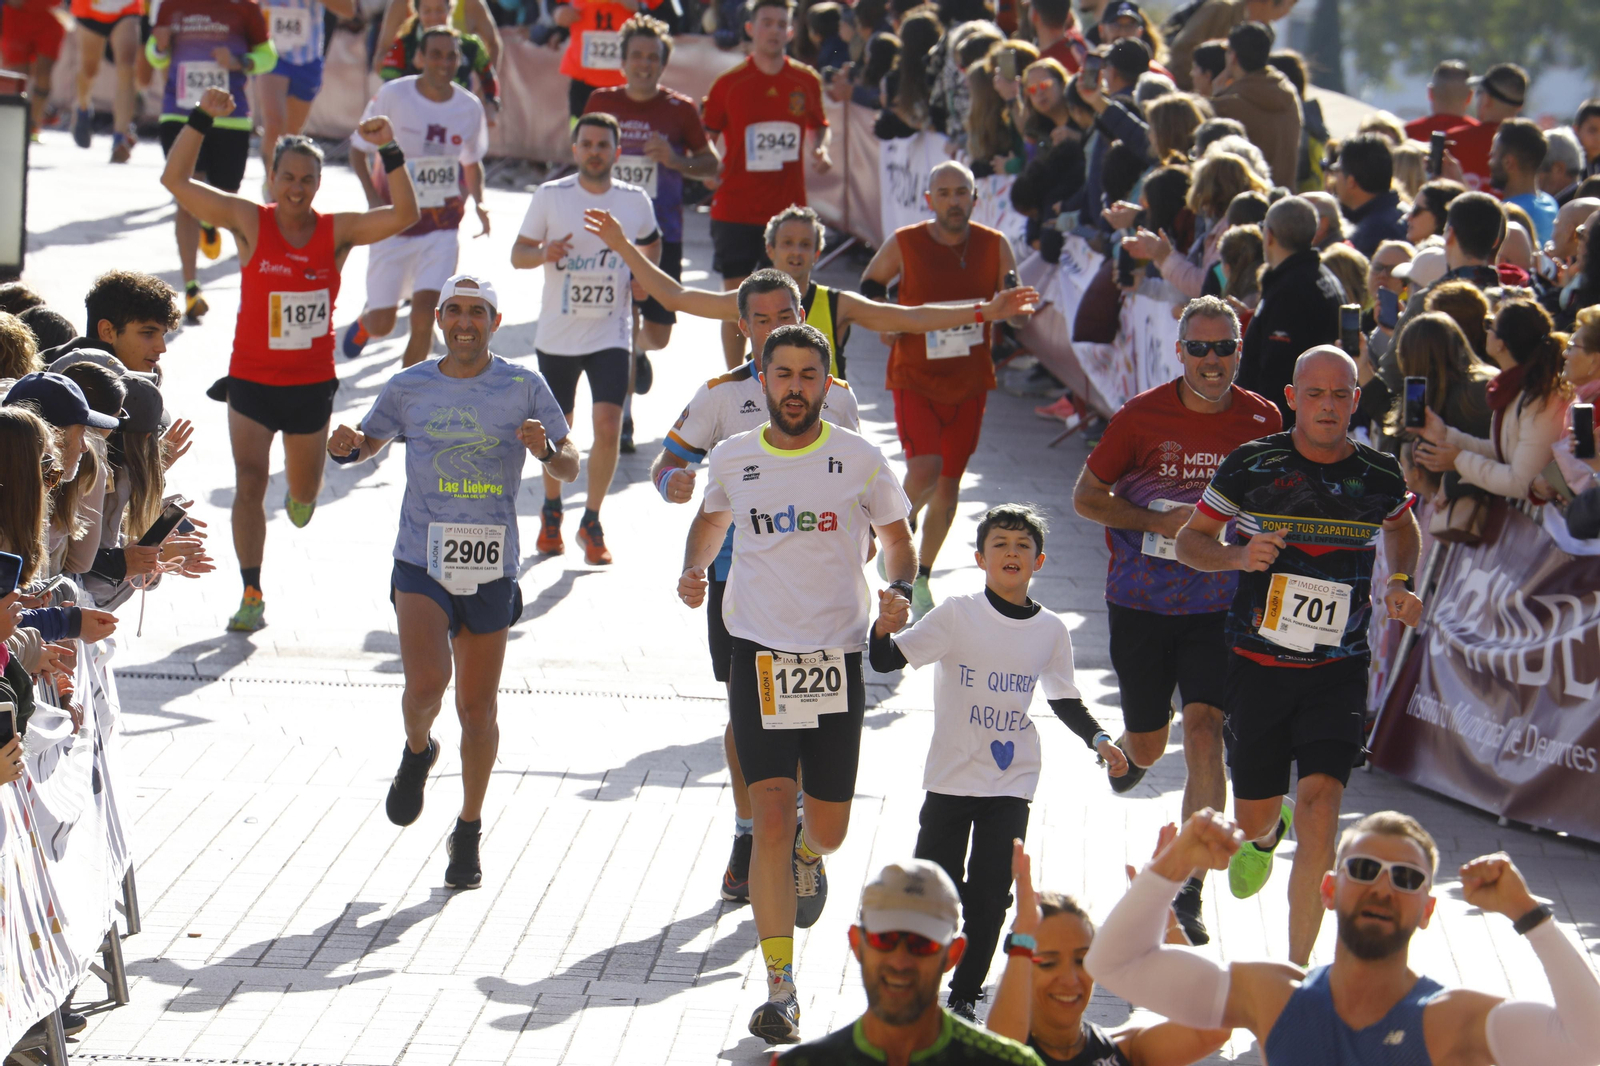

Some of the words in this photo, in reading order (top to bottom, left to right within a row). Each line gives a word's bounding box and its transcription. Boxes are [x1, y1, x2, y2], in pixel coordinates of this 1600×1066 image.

[757, 133, 797, 150] 2942
[417, 166, 455, 184] 4098
[614, 166, 653, 183] 3397
[571, 285, 614, 303] 3273
[284, 302, 326, 323] 1874
[1159, 464, 1178, 477] 36
[1183, 468, 1216, 480] MAR
[439, 478, 460, 493] Las
[463, 478, 503, 495] Liebres
[750, 504, 838, 535] indea
[1262, 520, 1293, 532] PONTE
[1297, 523, 1315, 533] TUS
[1316, 525, 1371, 539] ZAPATILLAS
[453, 527, 484, 535] IMDECO
[443, 539, 500, 565] 2906
[1297, 581, 1330, 594] IMDECO
[1270, 595, 1279, 617] CAJÓN
[1293, 593, 1337, 626] 701
[775, 666, 842, 695] 1220
[958, 664, 976, 688] TE
[987, 671, 1040, 693] QUEREM
[763, 677, 771, 702] CAJÓN
[969, 704, 1036, 732] ABUEL
[1522, 723, 1598, 773] Deportes
